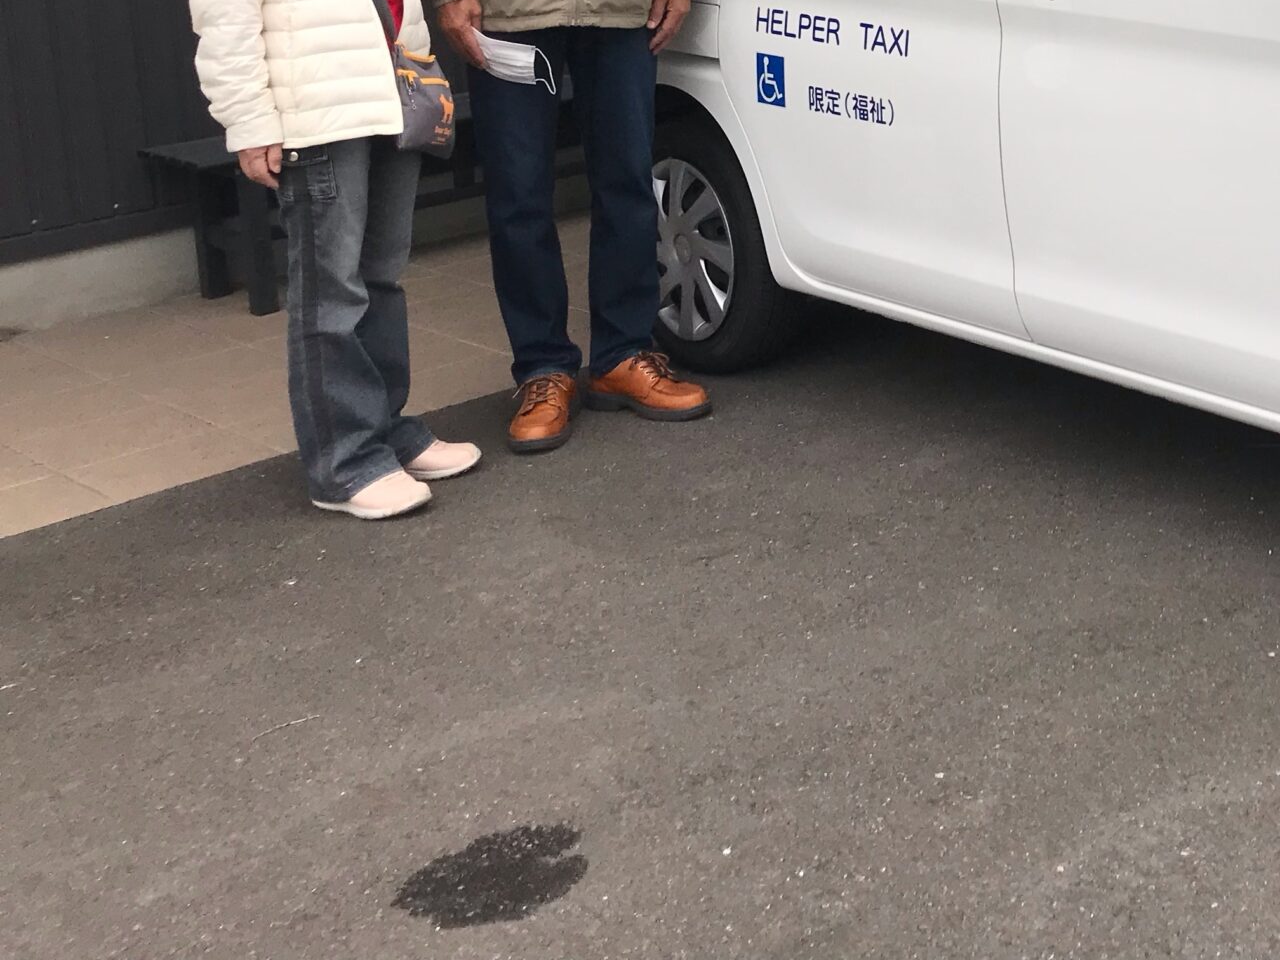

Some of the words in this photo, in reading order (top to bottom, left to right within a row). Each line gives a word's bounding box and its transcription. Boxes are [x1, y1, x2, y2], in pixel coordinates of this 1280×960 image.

[756, 7, 840, 46] HELPER
[859, 22, 910, 58] TAXI
[808, 85, 895, 127] 限定(福祉)
